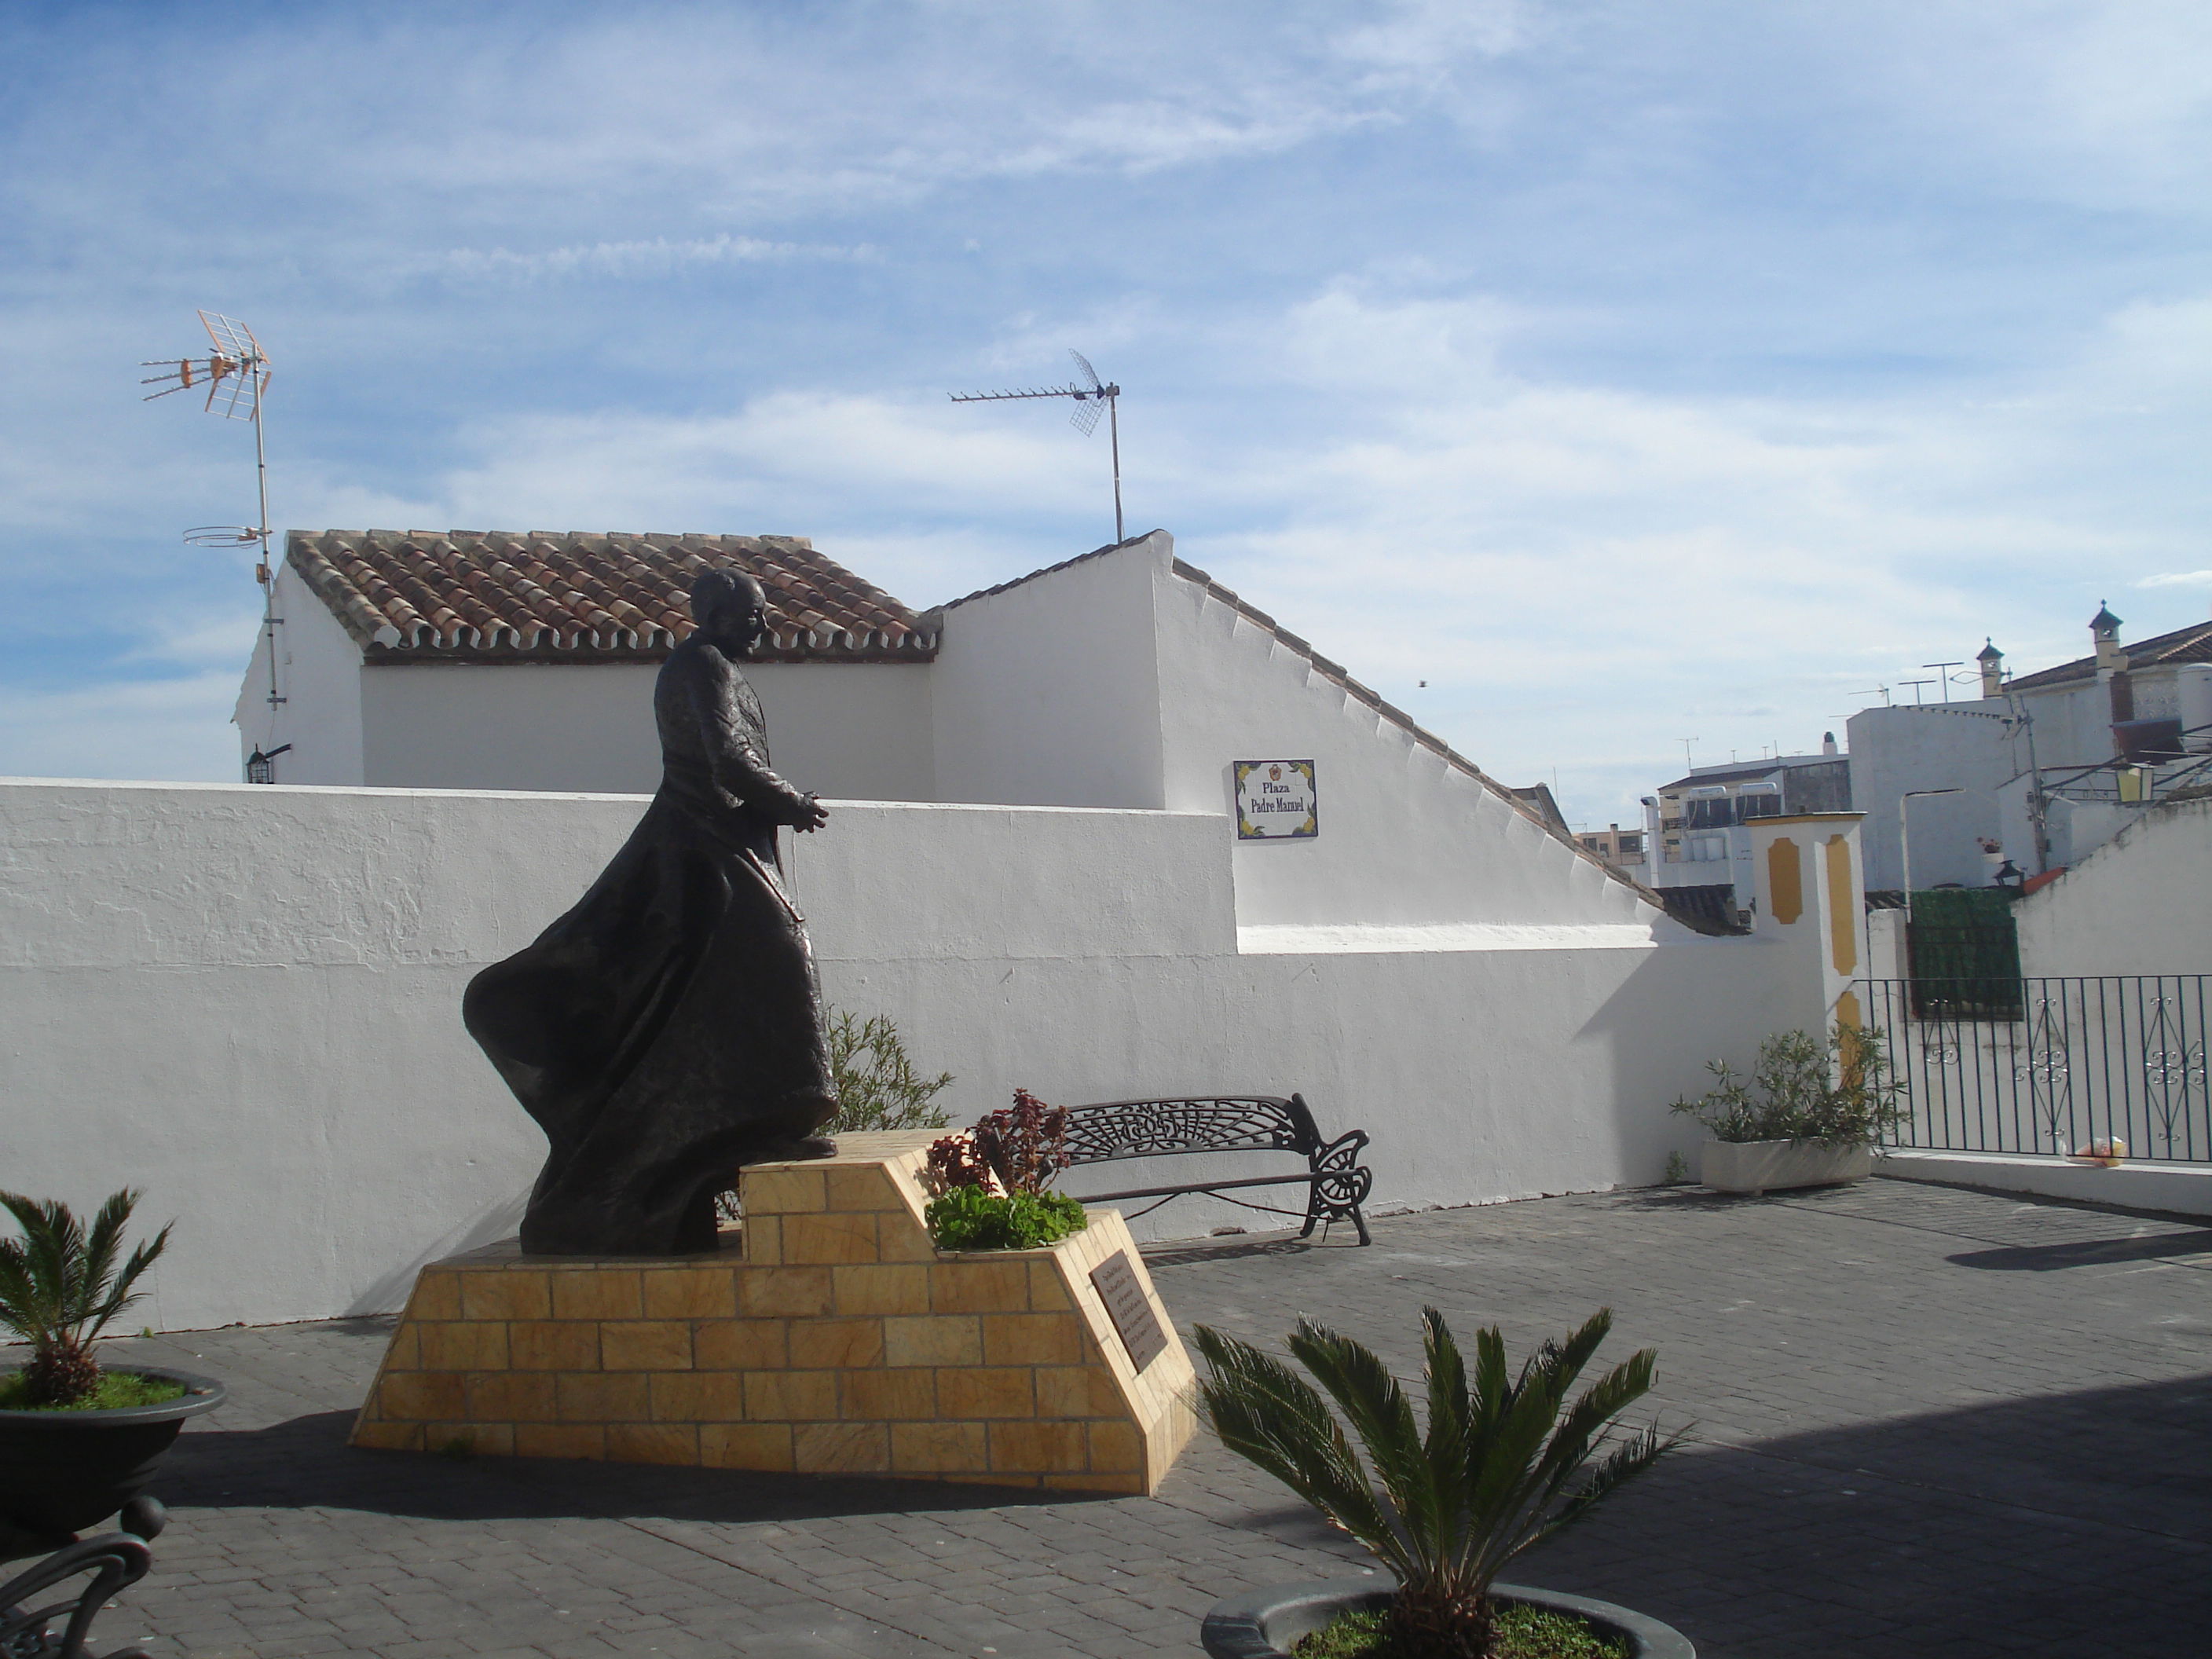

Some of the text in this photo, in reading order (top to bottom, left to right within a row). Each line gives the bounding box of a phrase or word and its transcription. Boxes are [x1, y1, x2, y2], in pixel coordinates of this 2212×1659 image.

[1262, 782, 1290, 793] Plaza
[1251, 797, 1305, 813] Padre Manuel
